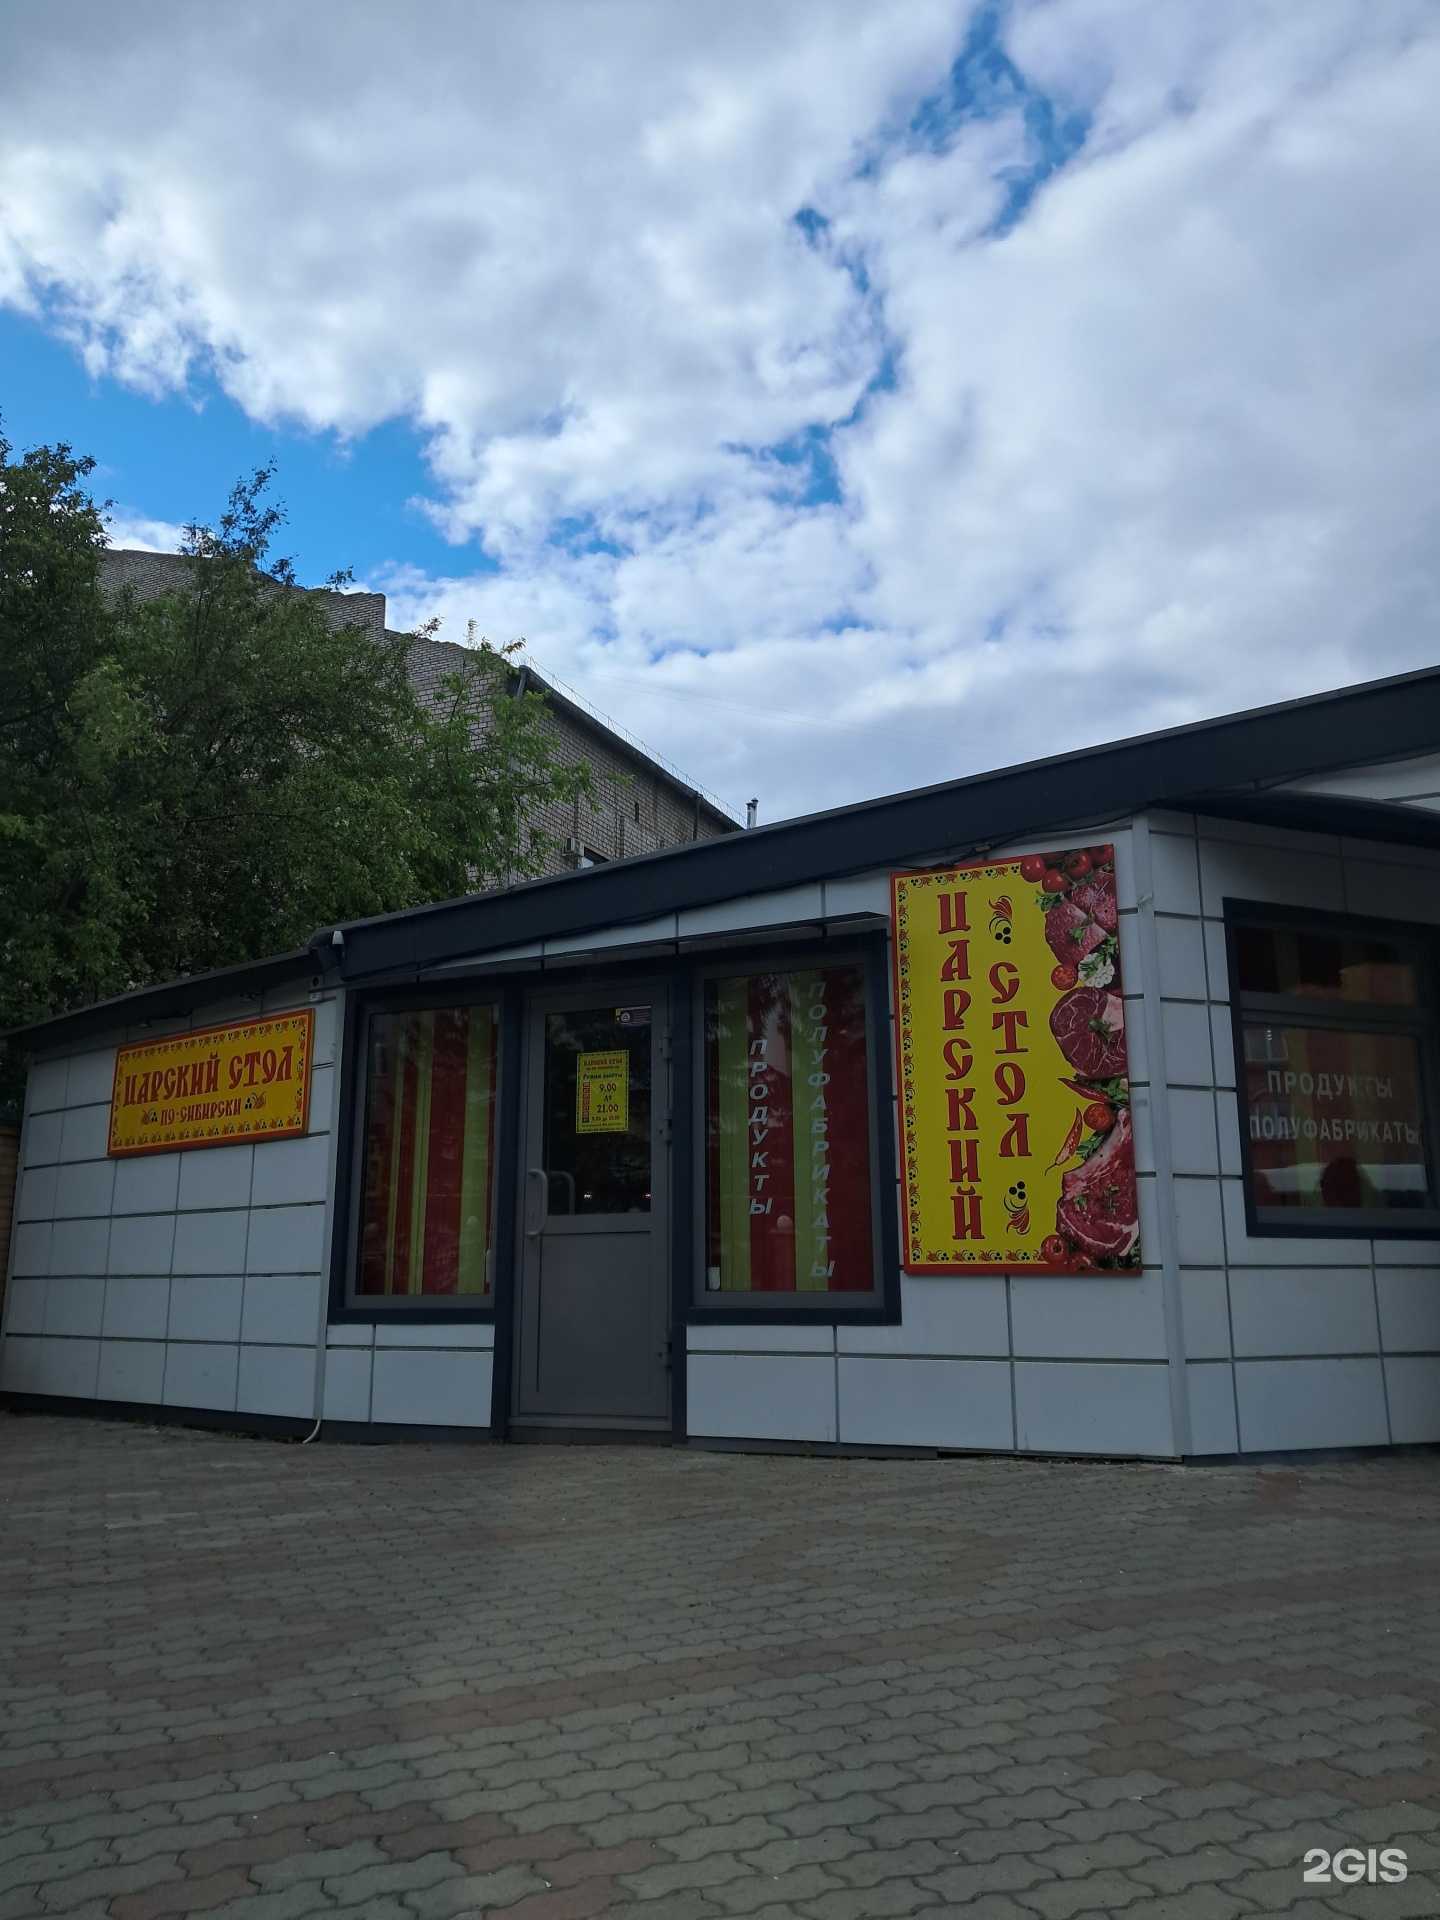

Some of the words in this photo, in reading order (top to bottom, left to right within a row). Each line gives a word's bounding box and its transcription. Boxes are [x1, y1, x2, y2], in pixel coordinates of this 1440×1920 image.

[123, 1052, 221, 1107] ЦАРСКИЙ
[228, 1045, 294, 1090] СТОЛ
[160, 1098, 242, 1126] ПО-СИБИРСКИ
[596, 1103, 619, 1113] 21.00
[937, 891, 986, 1241] ЦАРСКИЙ
[988, 961, 1033, 1158] СТОЛ
[750, 1039, 773, 1216] ПРОДУКТЫ
[807, 982, 835, 1278] ПОЛУФАБРИКАТЫ
[1250, 1114, 1421, 1145] ПОЛУФАБРИКАТЫ
